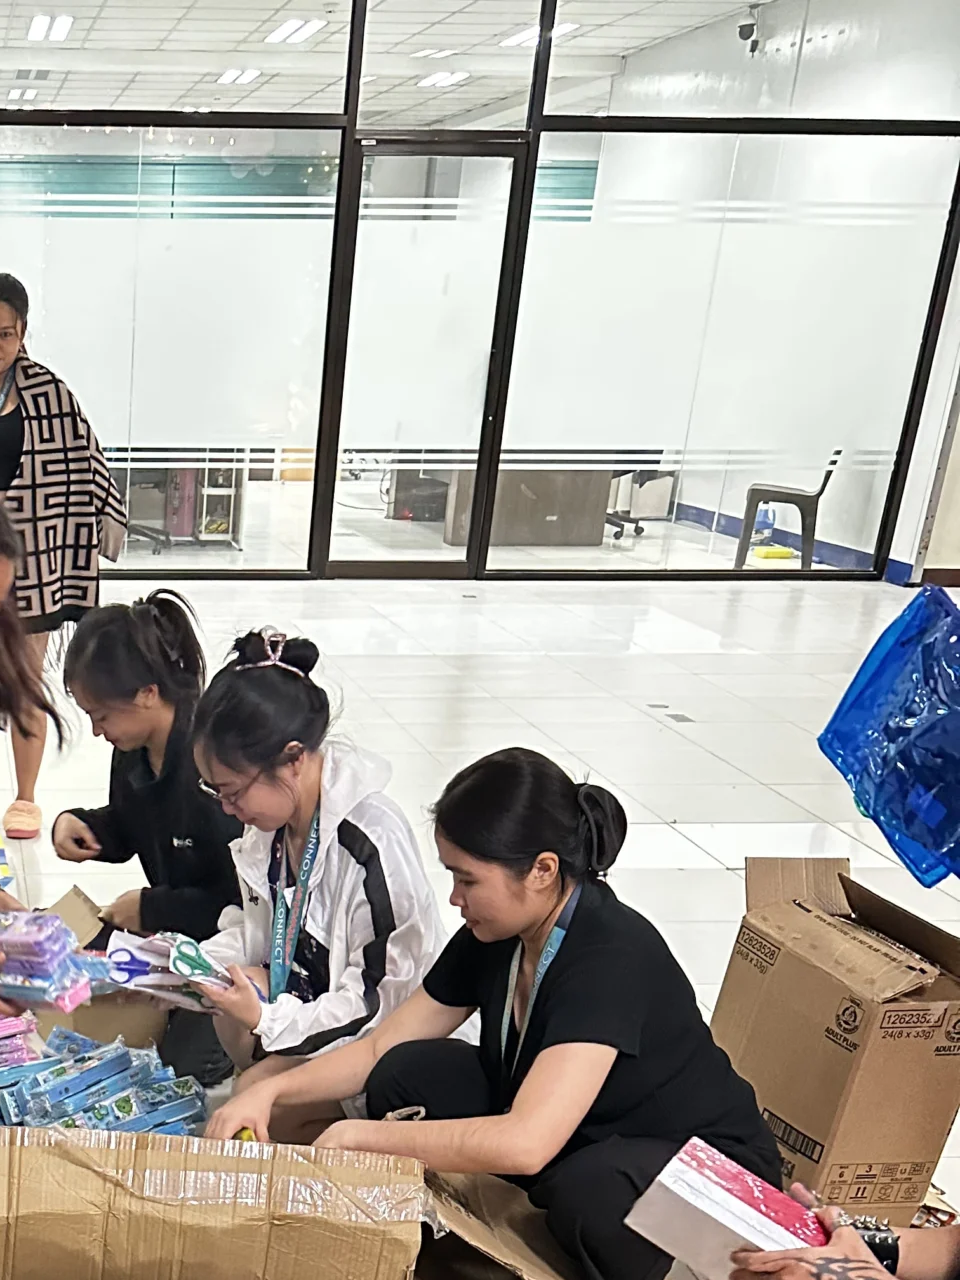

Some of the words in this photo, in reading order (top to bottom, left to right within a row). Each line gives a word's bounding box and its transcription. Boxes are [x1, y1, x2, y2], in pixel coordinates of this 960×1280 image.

[273, 898, 286, 966] CONNECT
[741, 931, 776, 961] 12623528
[824, 1026, 844, 1042] ADULT
[882, 1030, 904, 1040] 24(8
[913, 1029, 935, 1040] 33g)
[865, 1164, 873, 1173] 3
